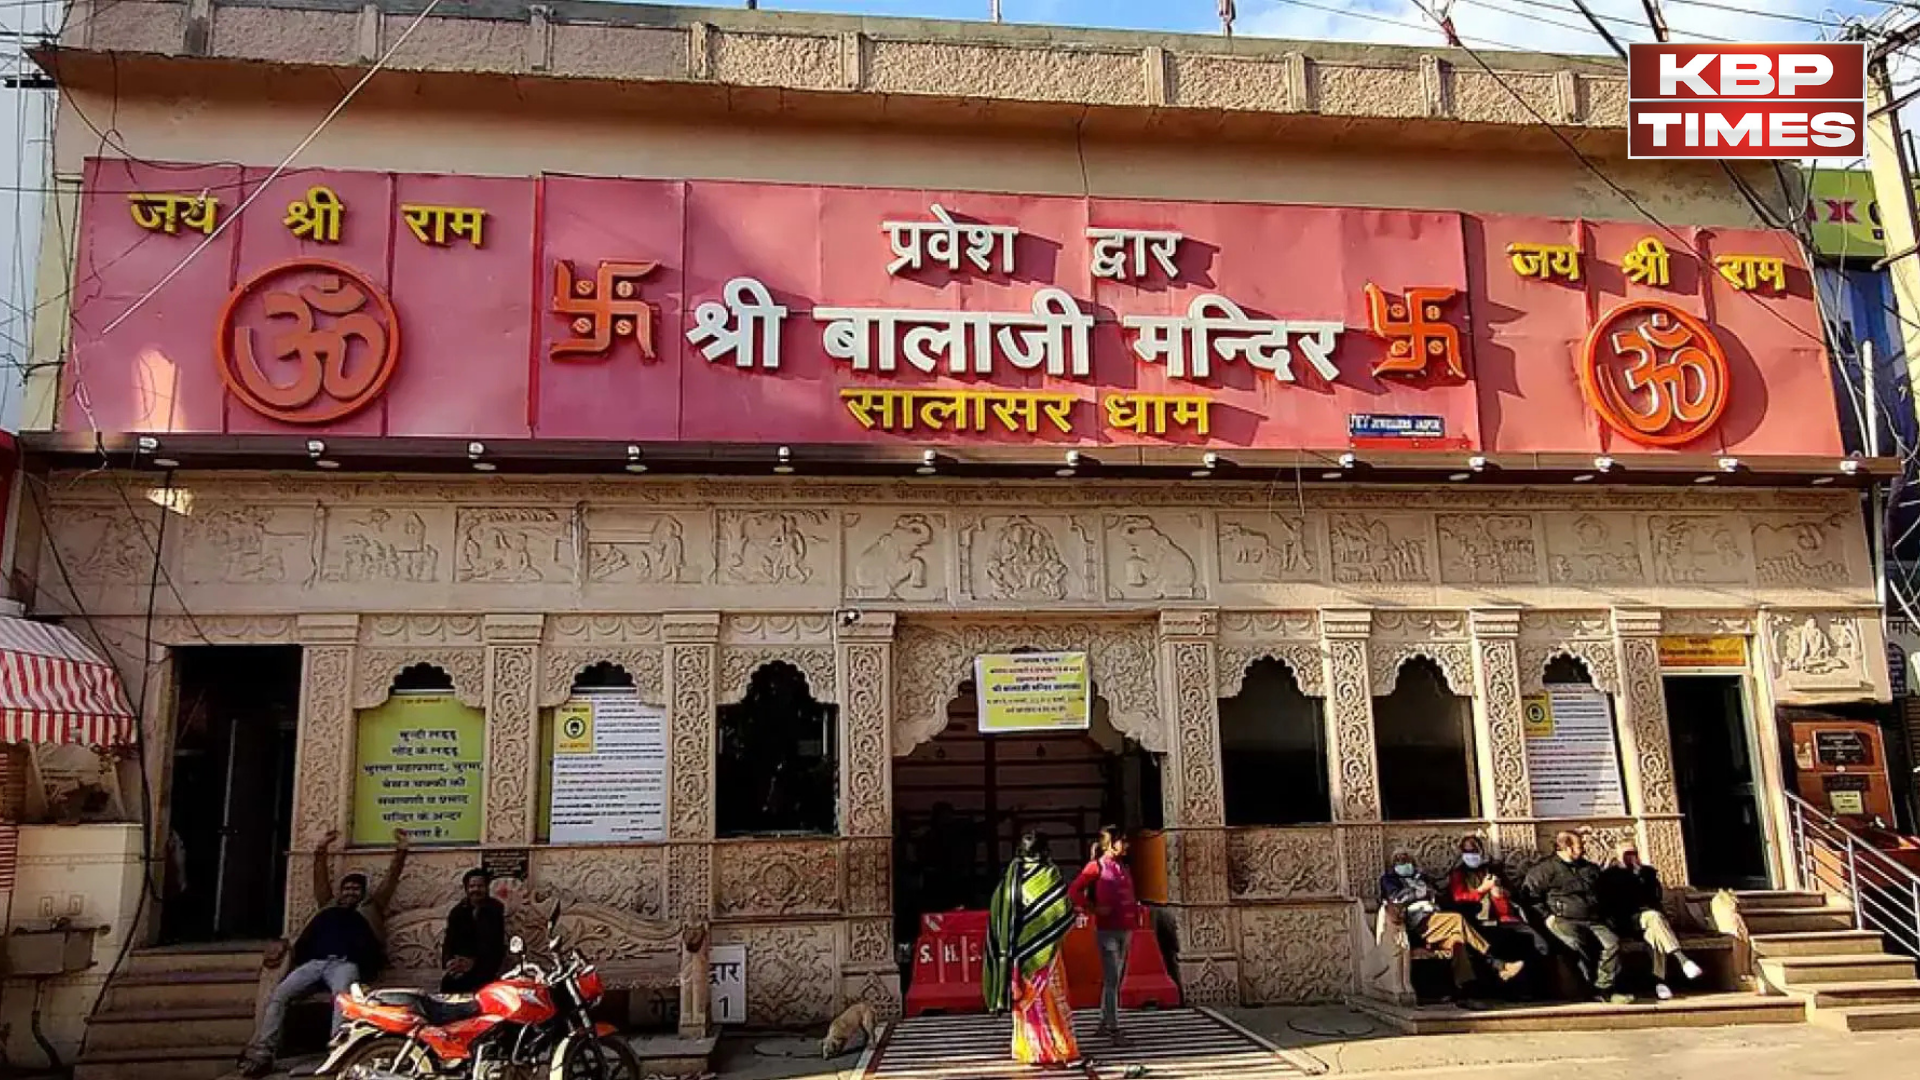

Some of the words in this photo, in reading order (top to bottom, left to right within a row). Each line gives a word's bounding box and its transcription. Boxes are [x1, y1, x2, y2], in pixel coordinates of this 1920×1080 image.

[127, 194, 219, 235] जय
[283, 185, 346, 243] श्री
[401, 203, 487, 247] राम
[882, 203, 1019, 276] प्रवेश
[1085, 227, 1183, 279] द्वार
[1506, 243, 1581, 282] जय
[1622, 235, 1670, 287] श्री
[1716, 254, 1788, 292] राम
[686, 276, 787, 369] श्री
[813, 288, 1095, 377] बालाजी
[1122, 293, 1346, 383] मन्दिर
[839, 388, 1078, 434] सालासर
[1098, 393, 1212, 436] धाम
[718, 995, 729, 1018] 1
